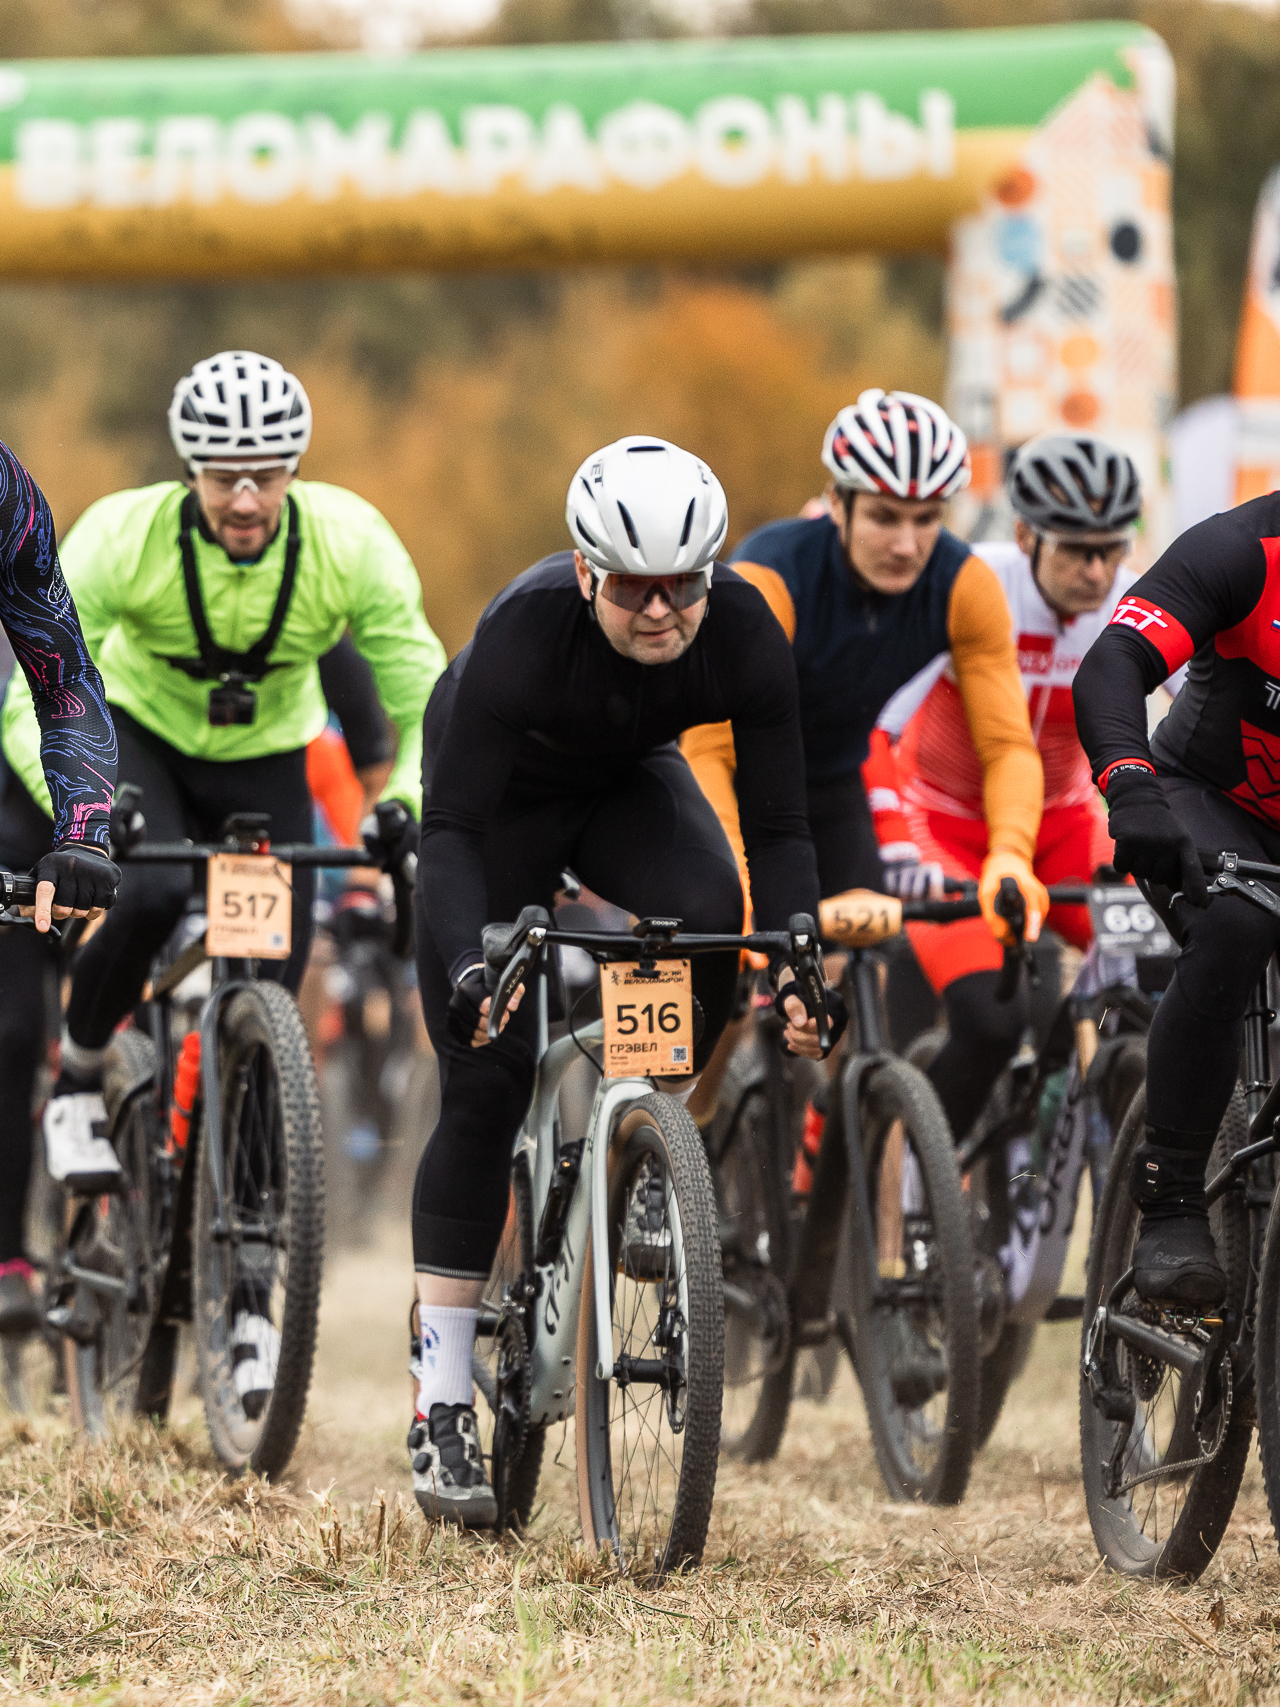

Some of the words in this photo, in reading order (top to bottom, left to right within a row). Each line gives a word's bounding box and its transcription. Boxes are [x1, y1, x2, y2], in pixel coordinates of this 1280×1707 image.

[14, 88, 957, 210] ВЕЛОМАРАФОНЫ
[223, 890, 278, 919] 517
[834, 906, 890, 934] 521
[616, 1002, 681, 1036] 516
[610, 1042, 658, 1054] ГРЭВЕЛ
